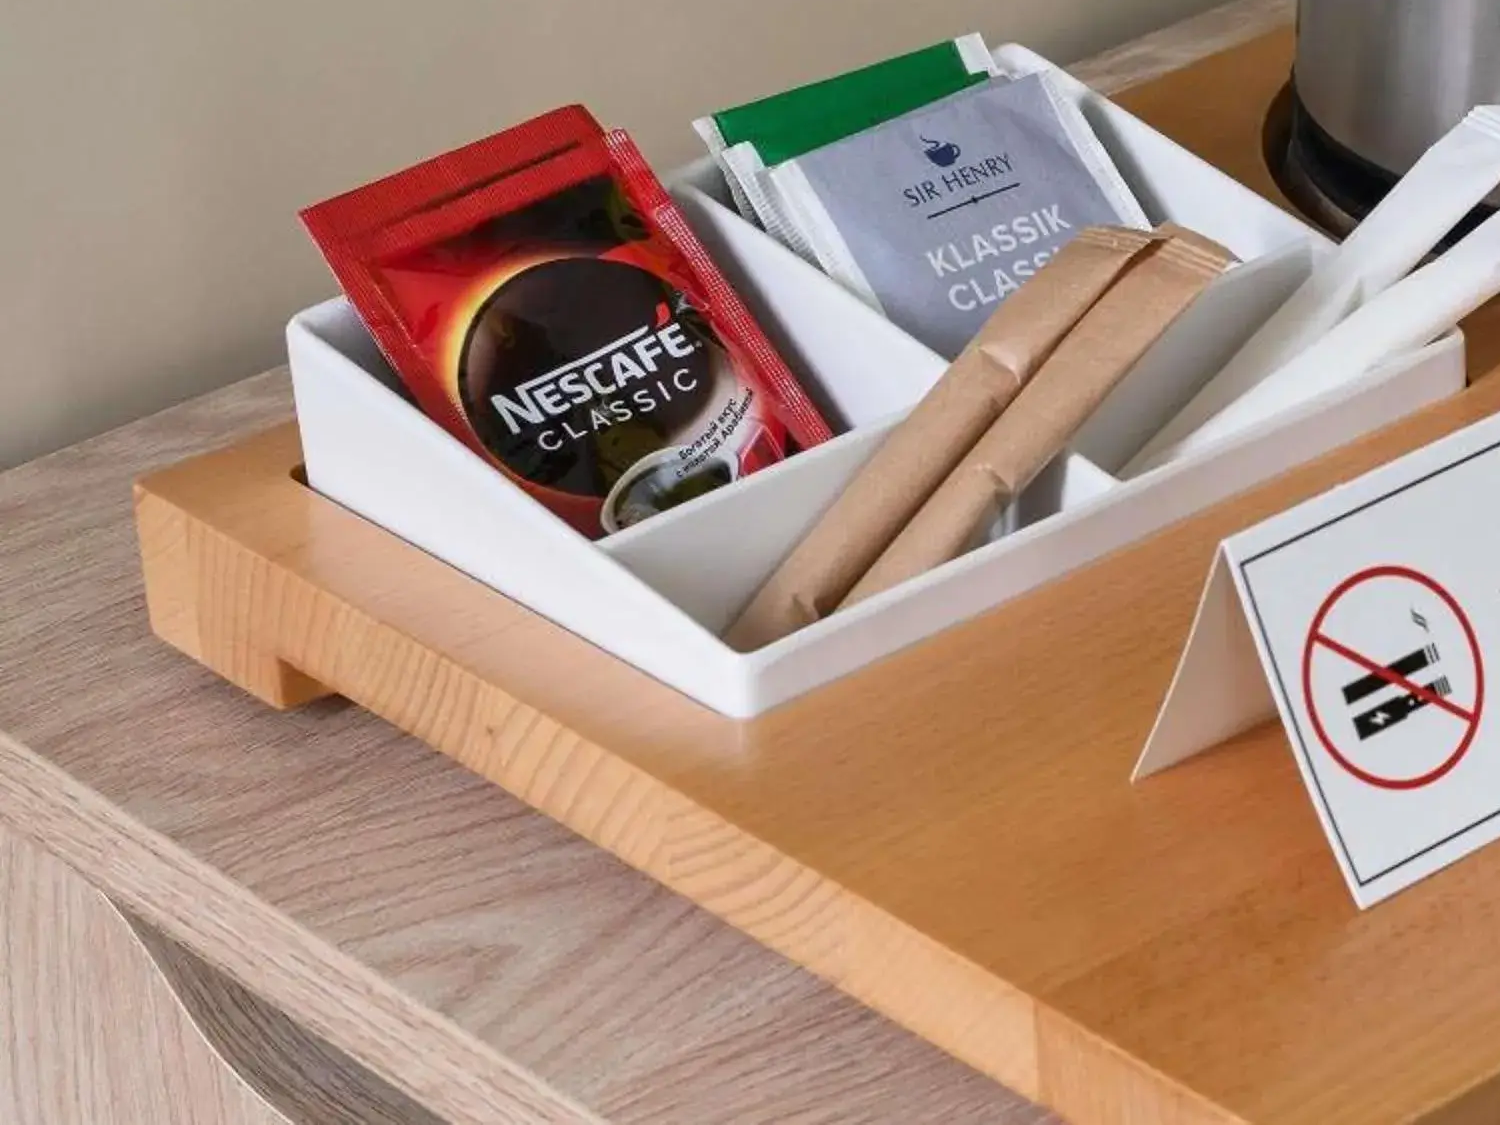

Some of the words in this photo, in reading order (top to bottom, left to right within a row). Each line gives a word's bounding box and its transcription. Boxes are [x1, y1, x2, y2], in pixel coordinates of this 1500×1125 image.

[903, 180, 942, 208] SIR
[941, 153, 1013, 192] HENRY
[925, 204, 1071, 277] KLASSIK
[948, 246, 1060, 311] CLAS
[490, 302, 695, 435] NESCAFÉ
[538, 368, 697, 451] CLASSIC
